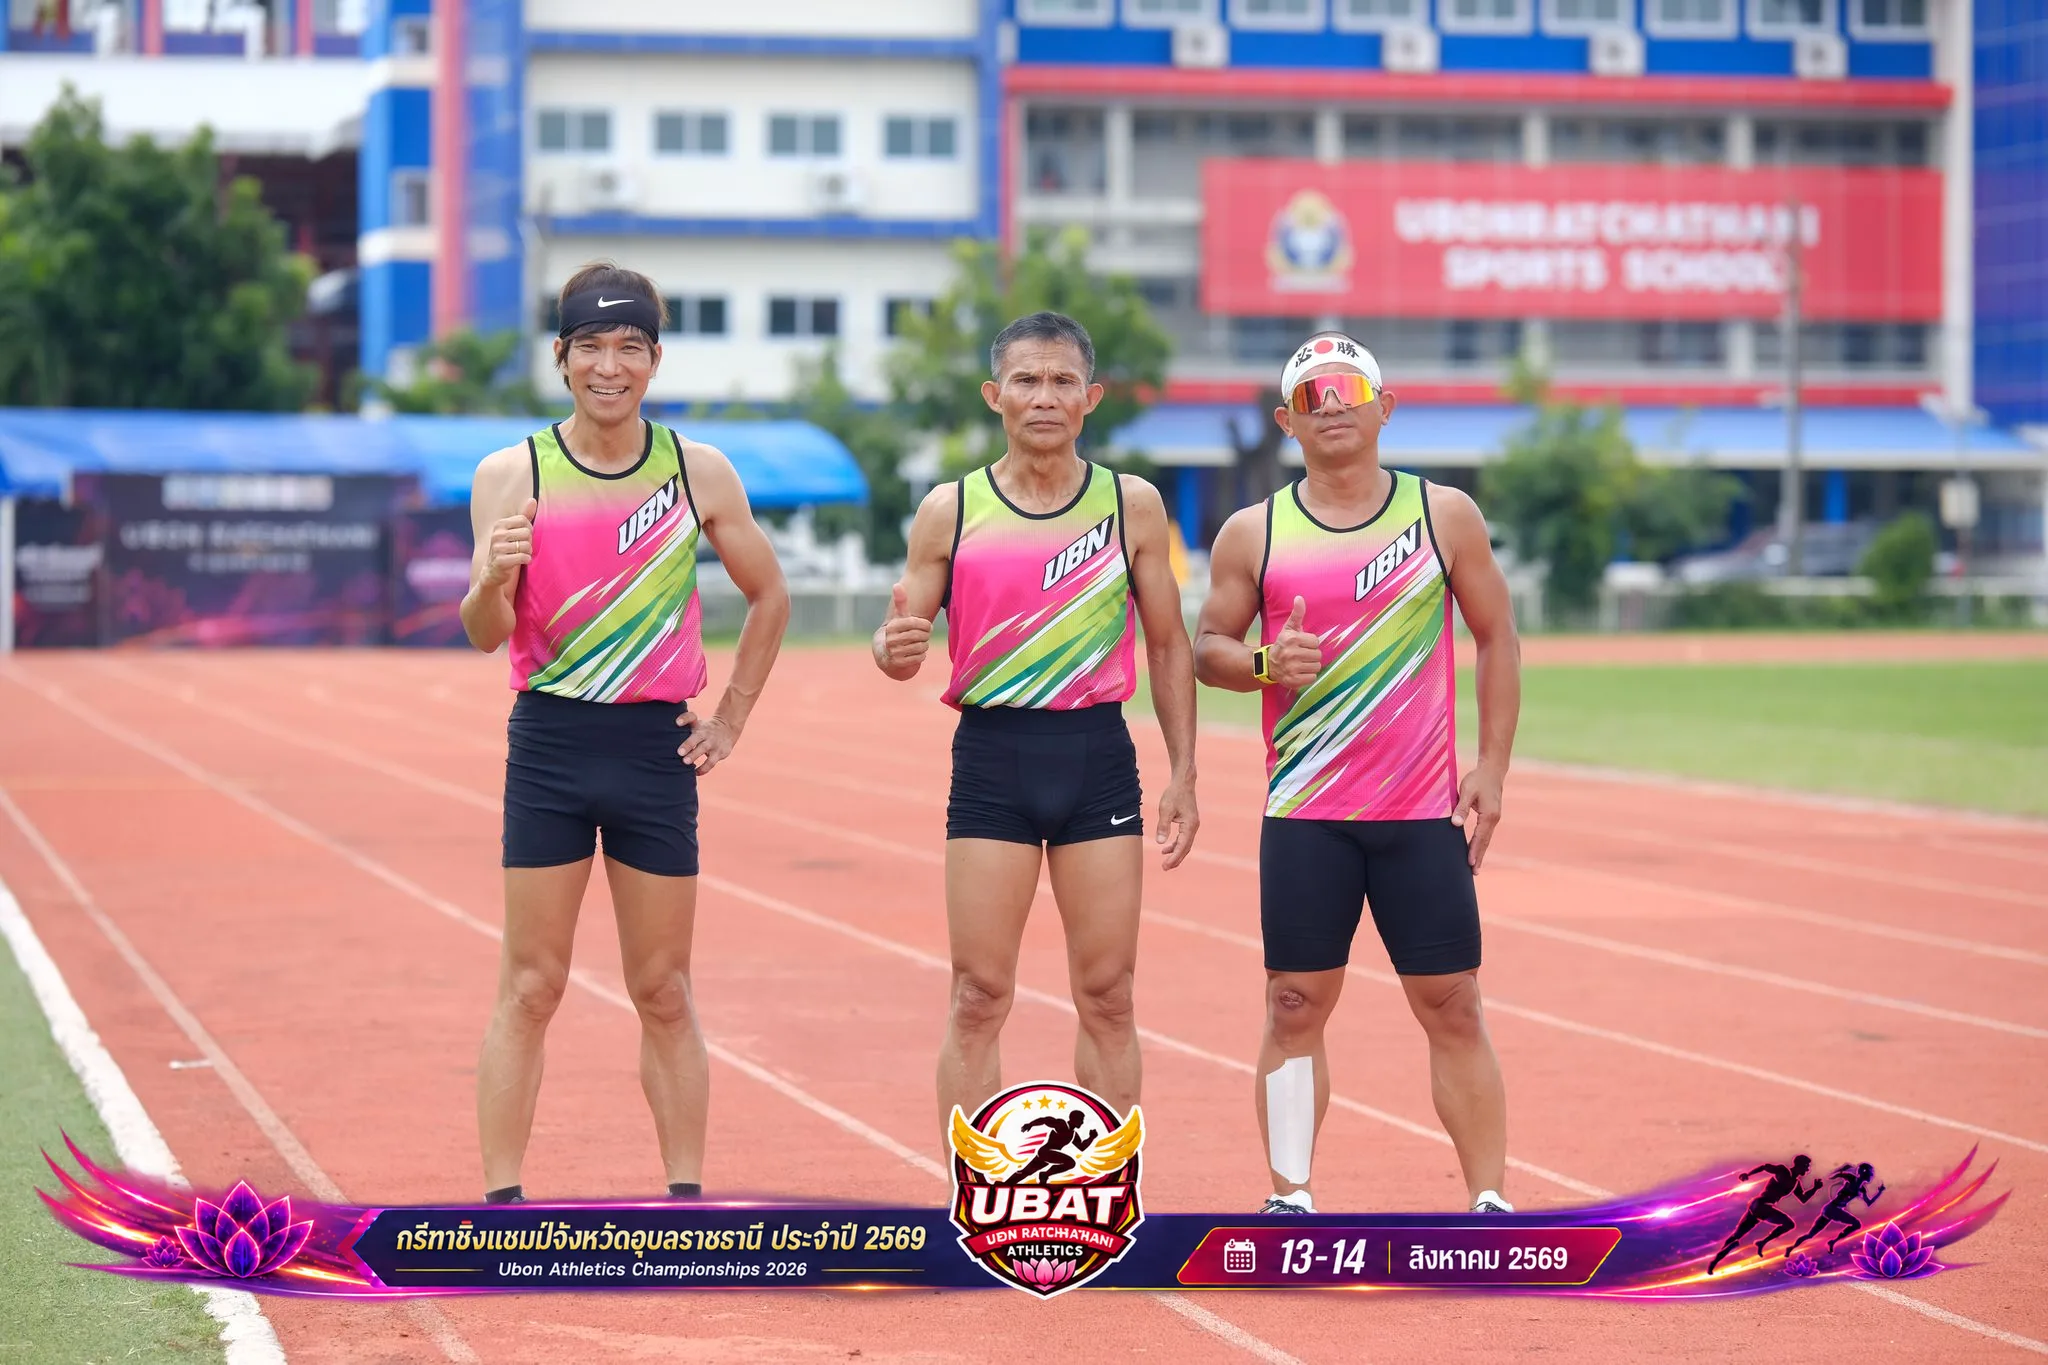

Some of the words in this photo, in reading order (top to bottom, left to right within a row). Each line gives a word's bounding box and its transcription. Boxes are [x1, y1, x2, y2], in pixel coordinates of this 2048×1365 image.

[1445, 250, 1608, 291] SPORTS
[618, 474, 678, 554] UBN
[1042, 513, 1114, 591] UBN
[1355, 518, 1421, 602] UBN
